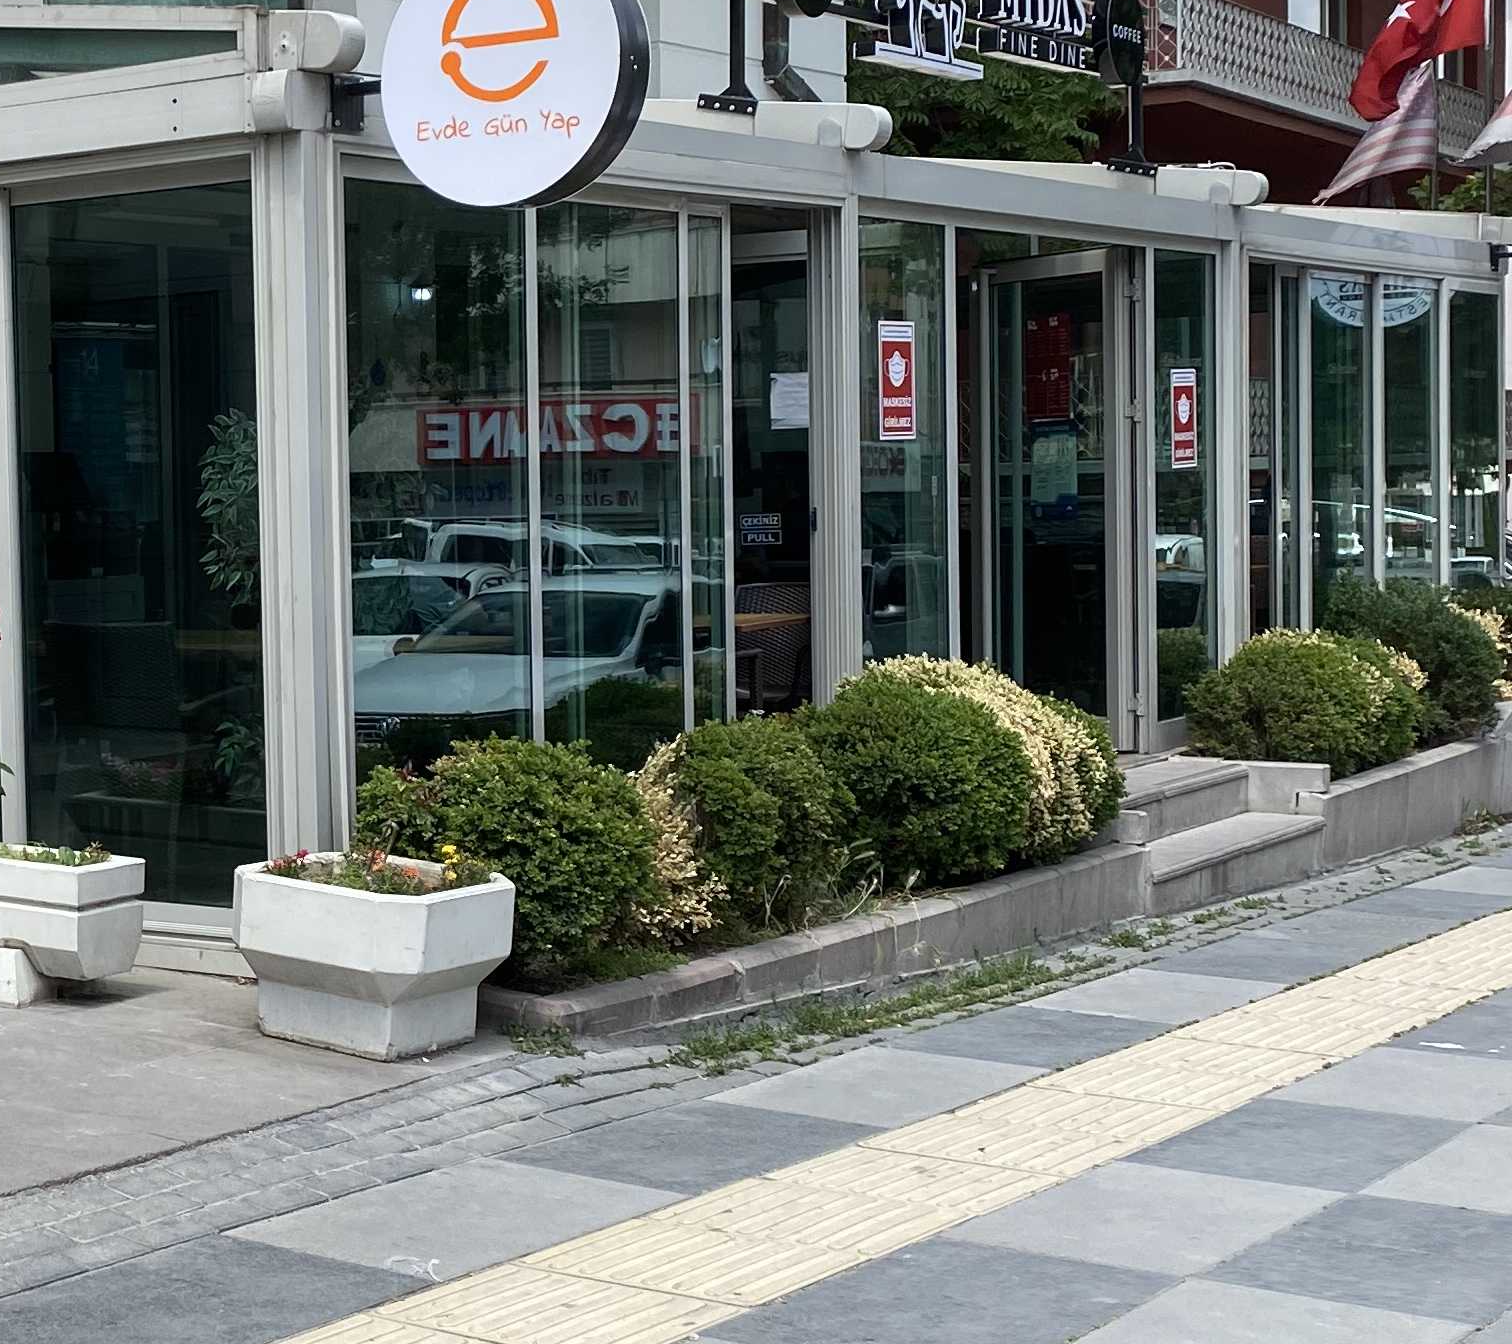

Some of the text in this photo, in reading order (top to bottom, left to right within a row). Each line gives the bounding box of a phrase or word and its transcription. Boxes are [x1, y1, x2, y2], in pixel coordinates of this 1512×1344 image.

[1112, 23, 1142, 44] COFFEE
[999, 28, 1086, 69] FINE DINE
[416, 109, 581, 142] Evde Gün Yap
[747, 533, 775, 542] PULL
